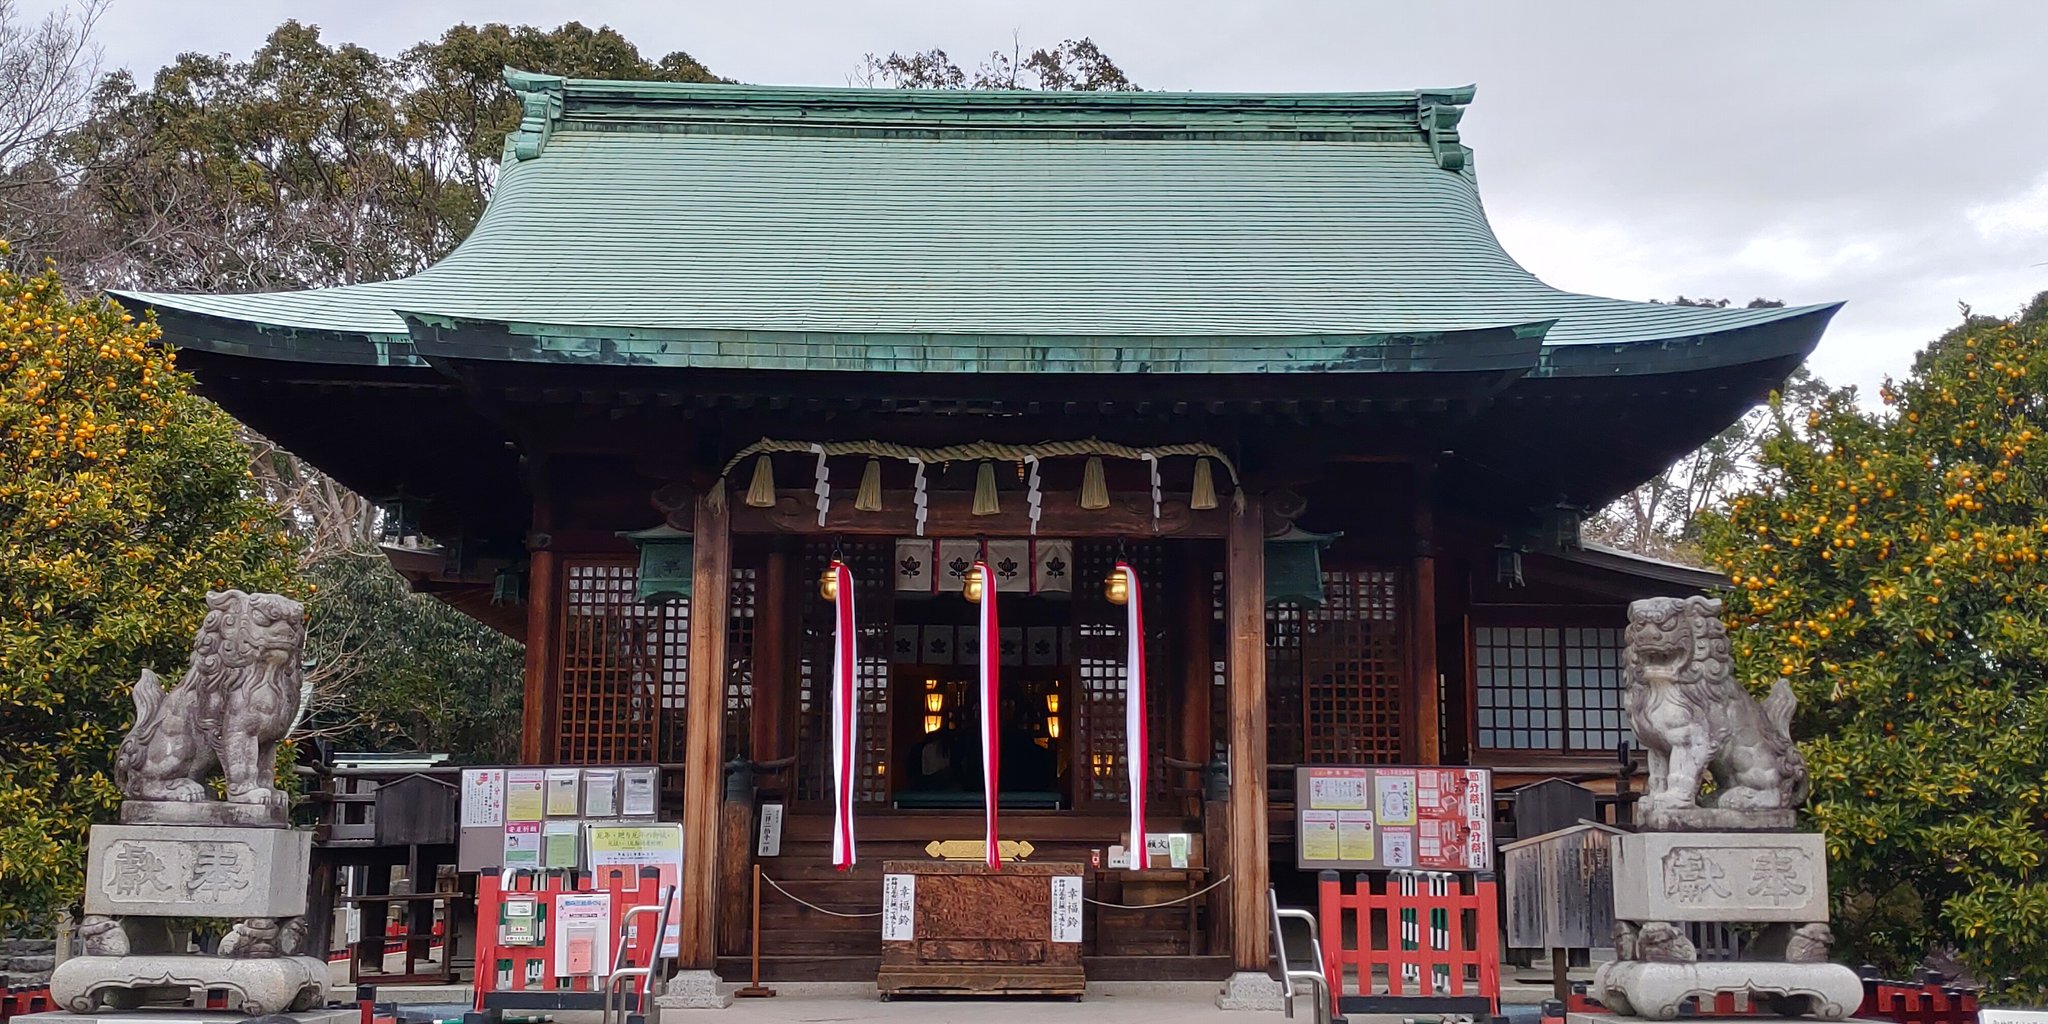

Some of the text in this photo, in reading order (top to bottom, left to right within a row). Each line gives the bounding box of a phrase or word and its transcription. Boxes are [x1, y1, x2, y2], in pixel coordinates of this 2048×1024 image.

[1469, 772, 1479, 804] 節分祭
[1471, 820, 1481, 853] 節分祭
[899, 885, 910, 926] 幸福鈴
[1067, 887, 1078, 928] 幸福鈴
